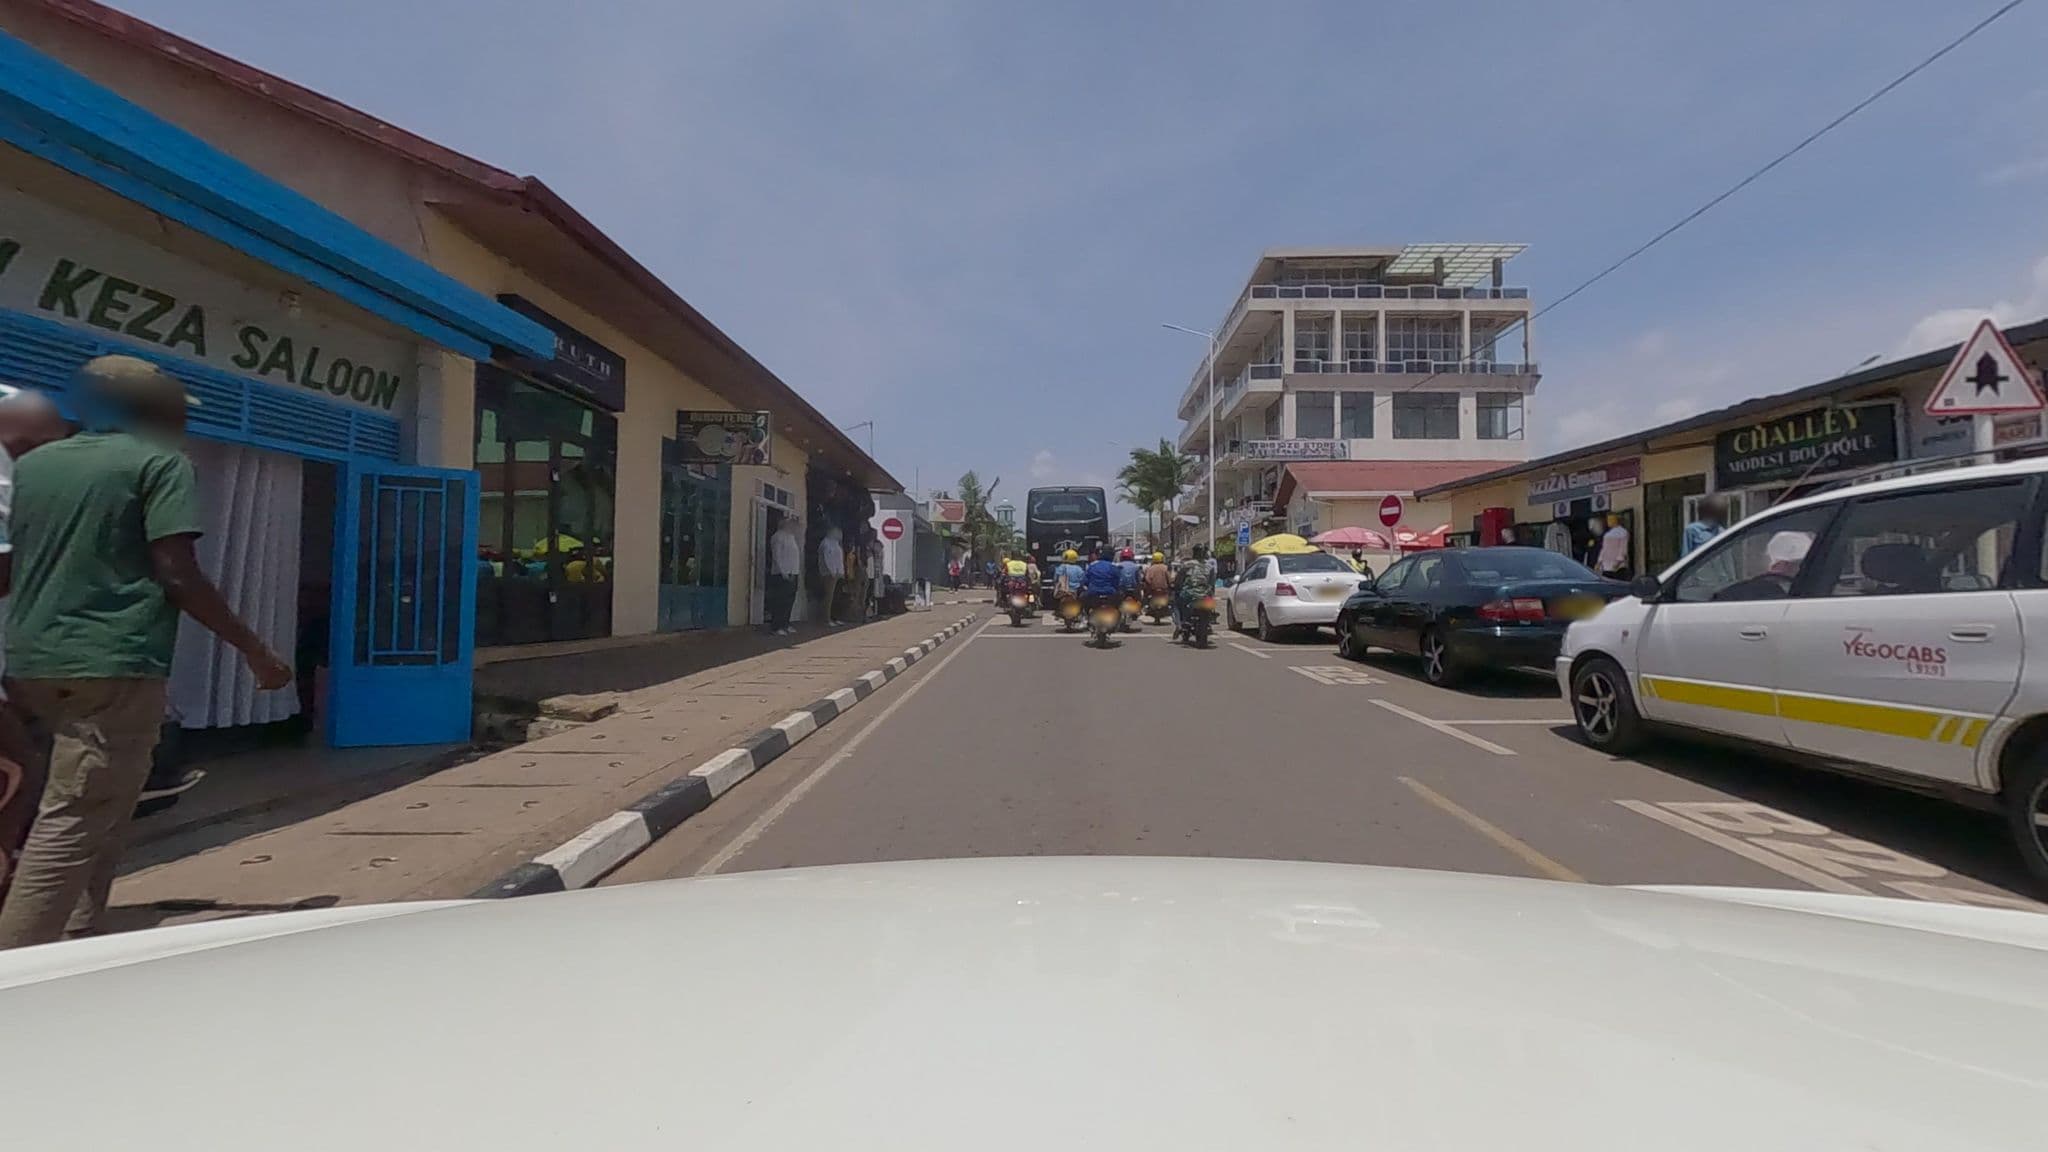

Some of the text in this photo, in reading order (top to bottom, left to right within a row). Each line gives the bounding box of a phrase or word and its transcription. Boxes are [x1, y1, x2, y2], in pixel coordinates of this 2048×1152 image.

[37, 258, 400, 410] KEZA SALOON
[1733, 407, 1859, 454] CHALLEY
[1728, 452, 1784, 474] MODEST
[1788, 433, 1874, 464] BOUTIQUE
[1240, 522, 1249, 532] P
[1843, 632, 1947, 664] YEGOCABS
